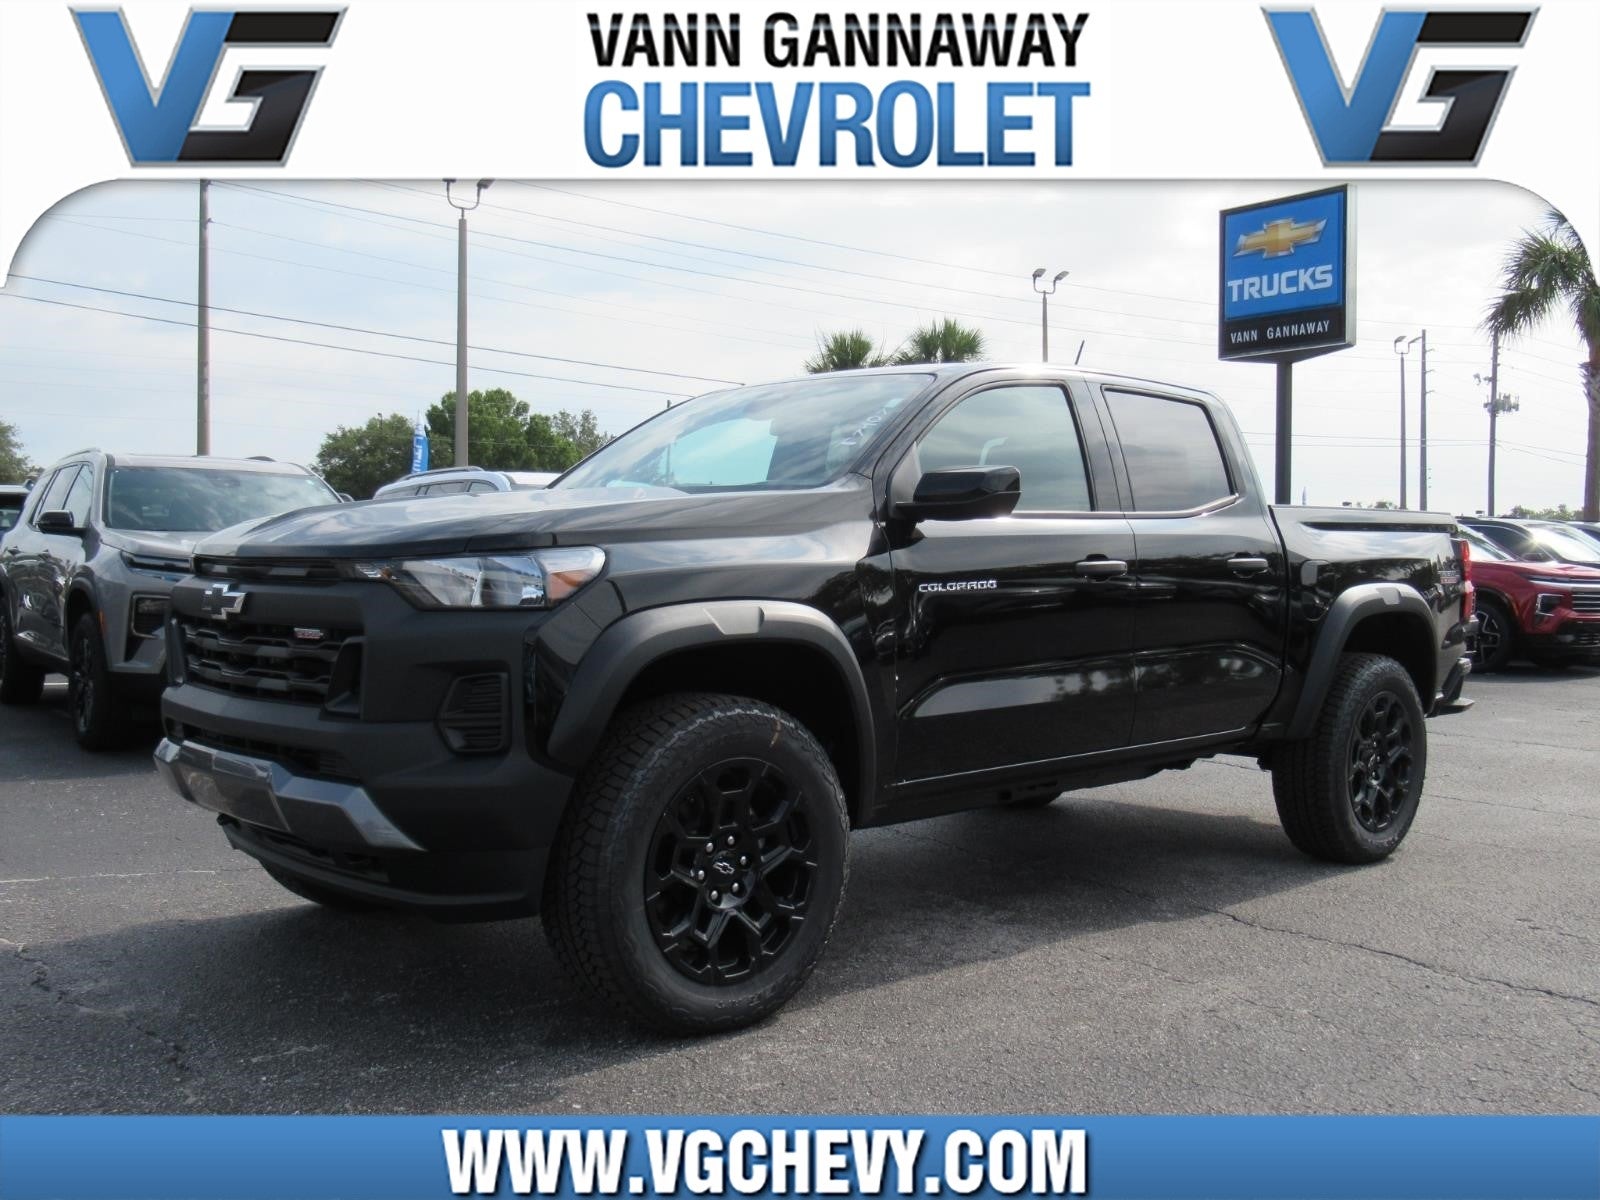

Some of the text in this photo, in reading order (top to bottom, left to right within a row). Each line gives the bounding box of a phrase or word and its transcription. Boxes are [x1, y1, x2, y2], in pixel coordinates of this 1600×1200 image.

[1227, 264, 1333, 302] TRUCKS
[1230, 319, 1330, 344] VANN GANNAWAY
[918, 579, 998, 593] COLORADO
